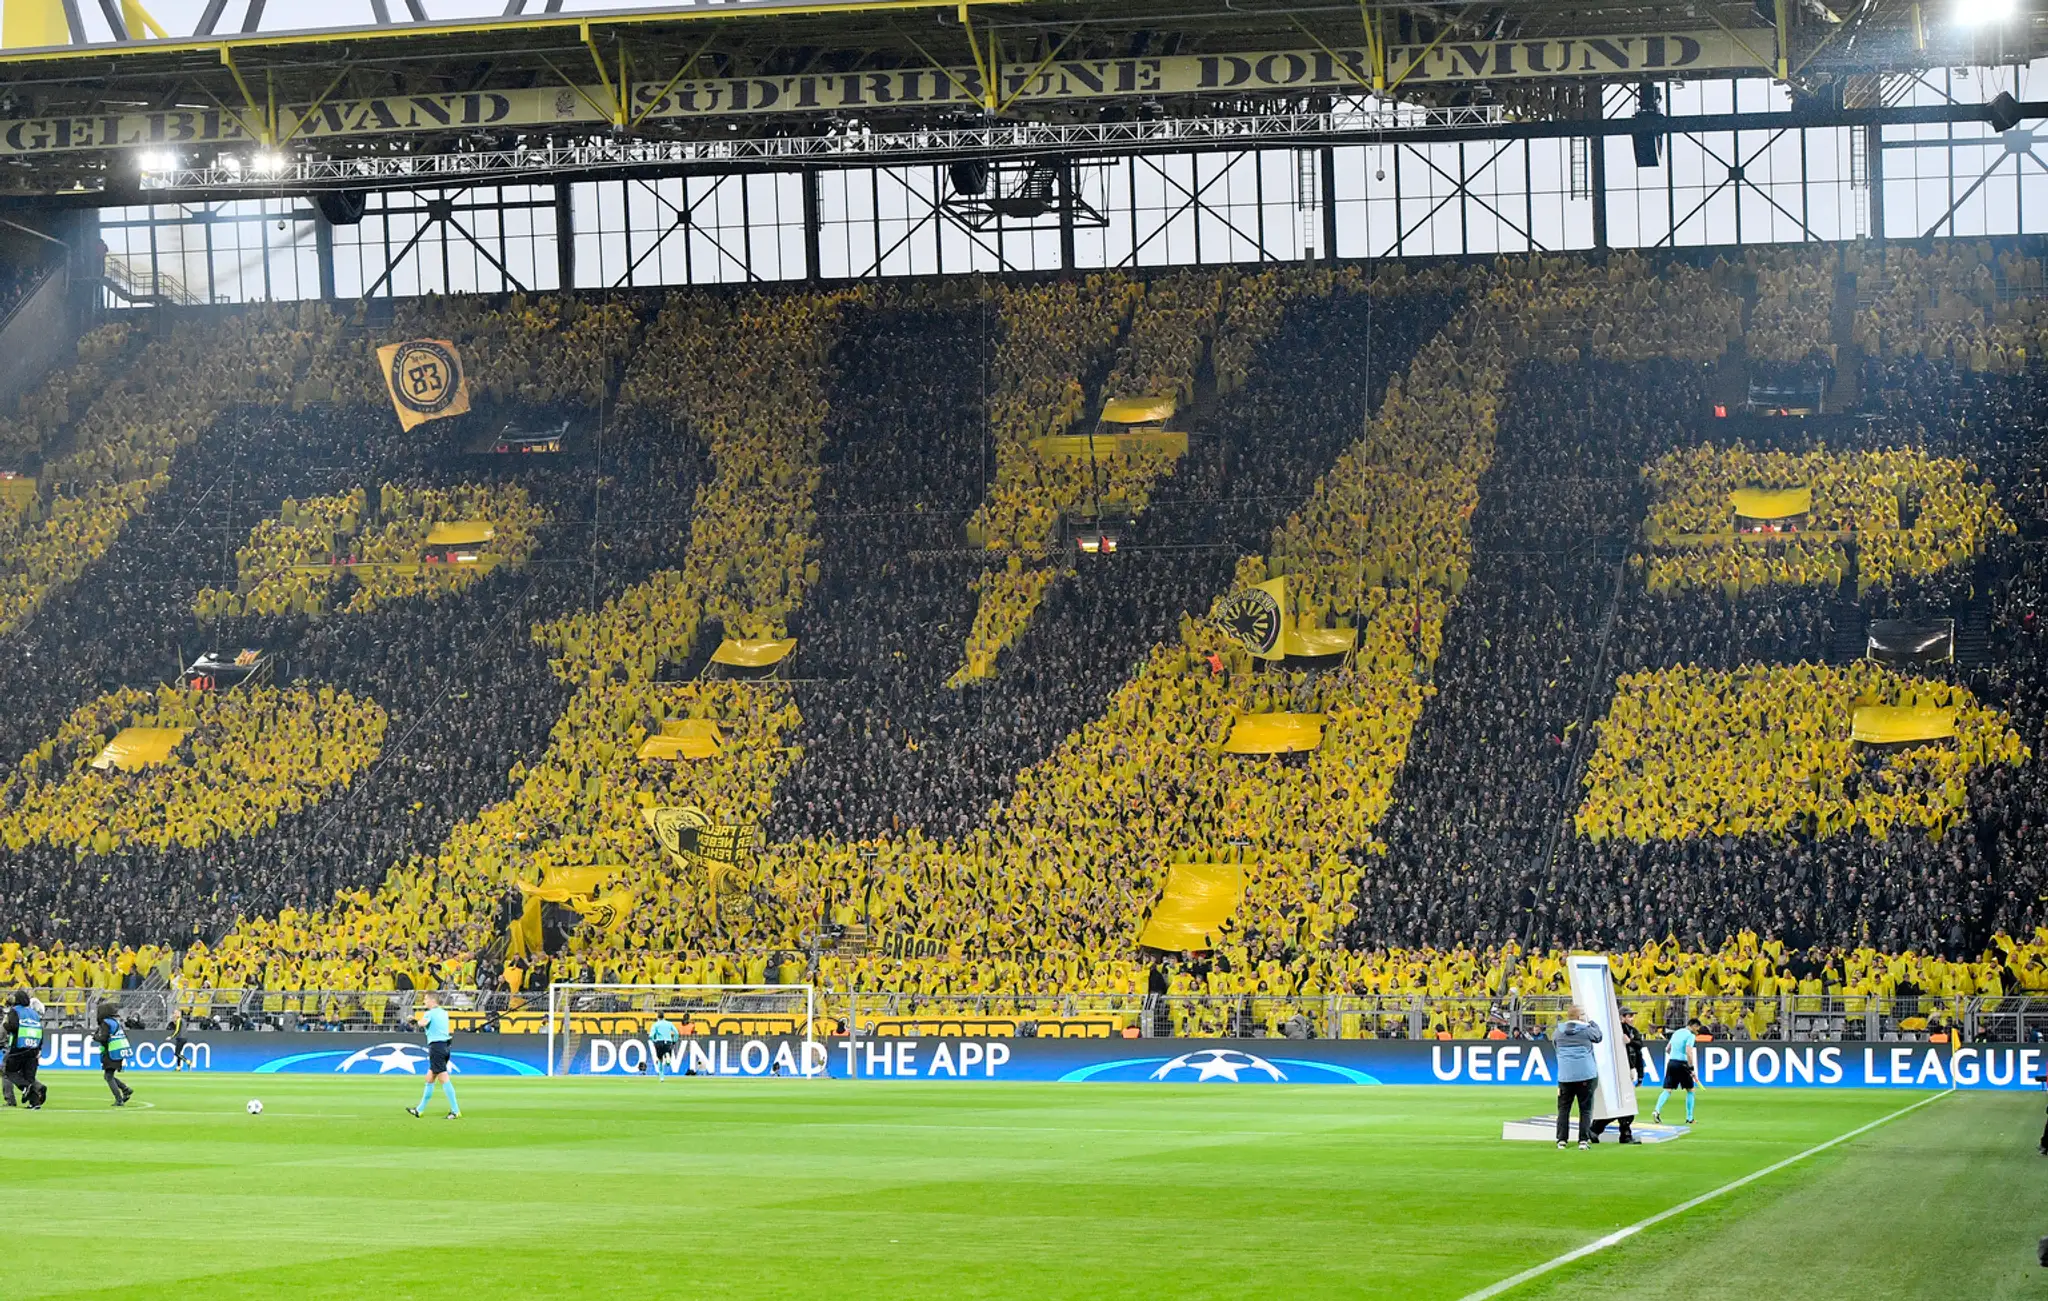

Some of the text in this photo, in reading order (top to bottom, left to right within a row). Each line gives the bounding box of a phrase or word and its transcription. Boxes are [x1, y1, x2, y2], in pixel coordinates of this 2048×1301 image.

[1196, 34, 1701, 88] DORTMUND
[6, 94, 510, 151] GELBE WAND
[408, 363, 443, 395] 83
[590, 1038, 1011, 1077] DOWNLOAD THE APP
[1431, 1045, 1552, 1082] UEFA
[1863, 1047, 2042, 1086] LEAGUE
